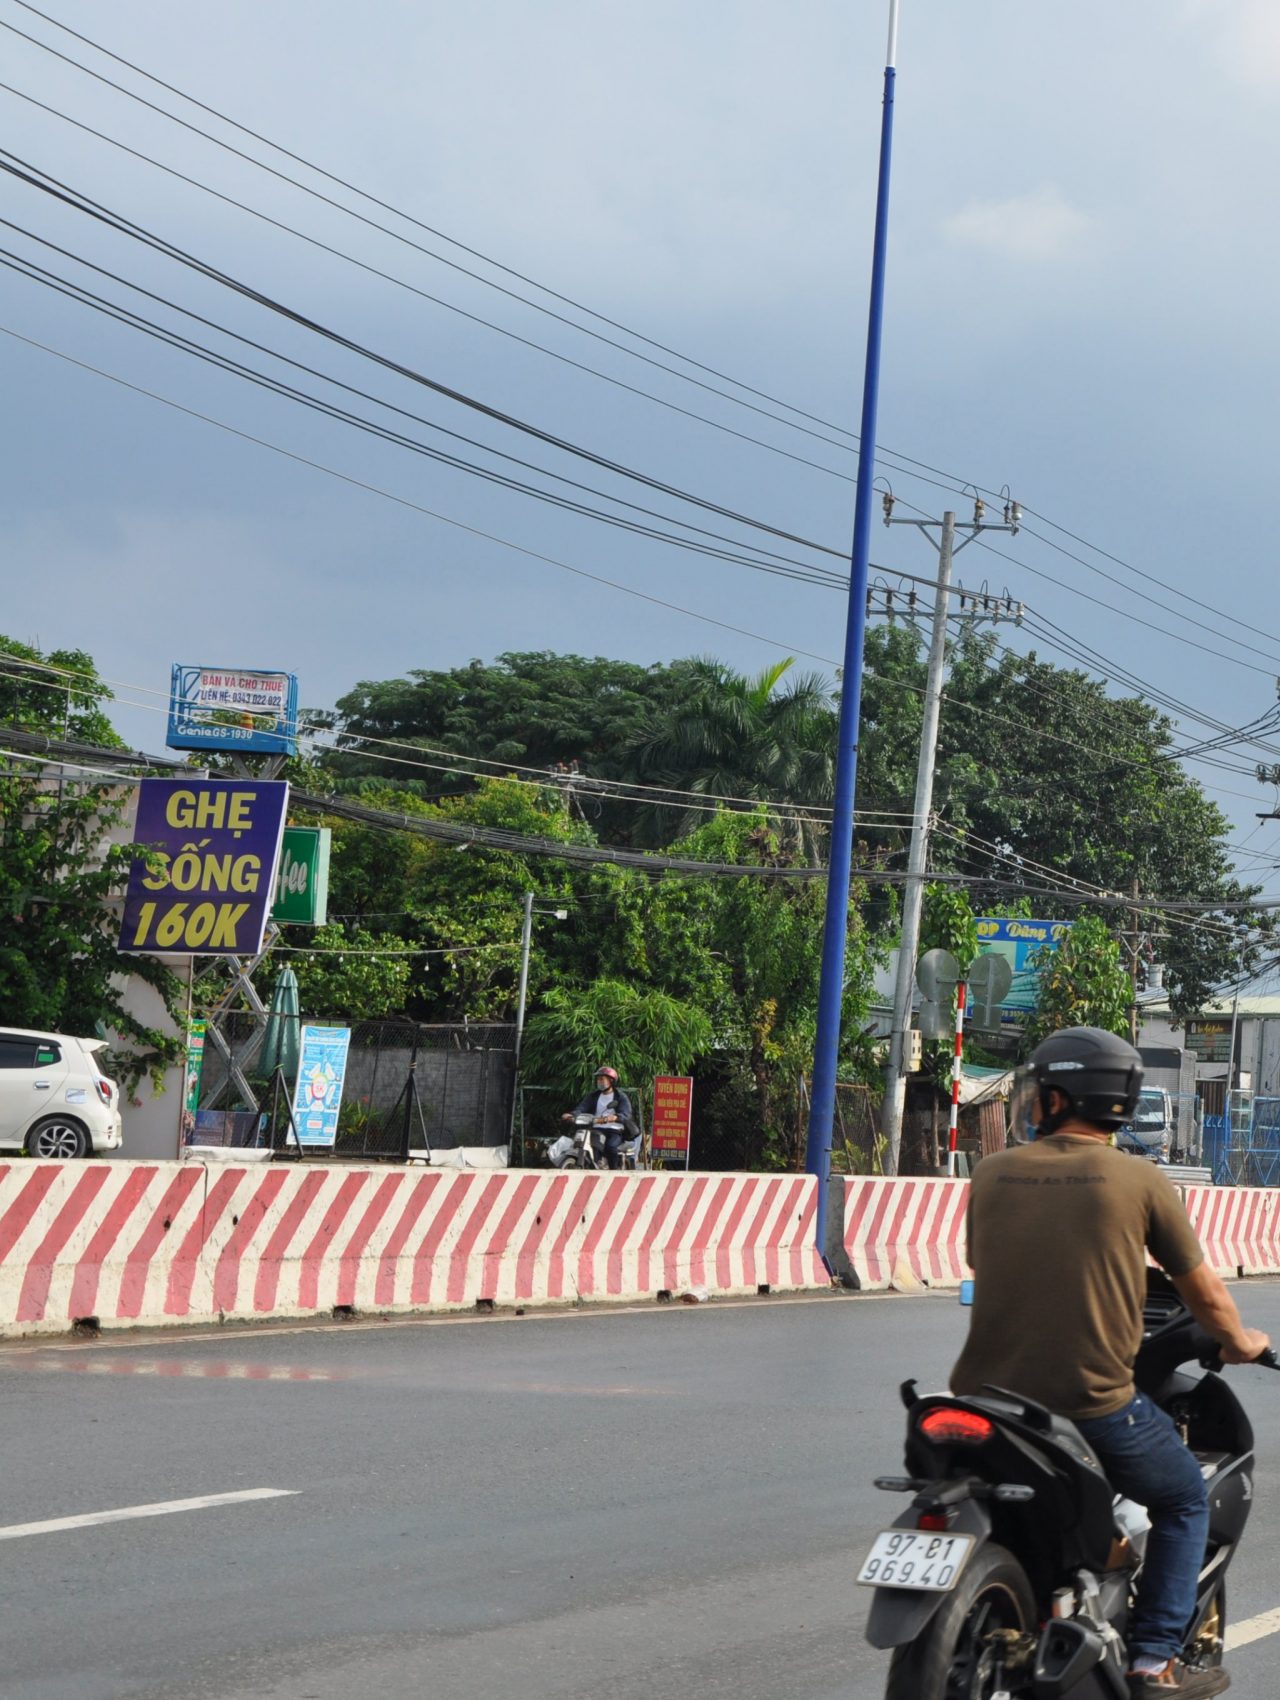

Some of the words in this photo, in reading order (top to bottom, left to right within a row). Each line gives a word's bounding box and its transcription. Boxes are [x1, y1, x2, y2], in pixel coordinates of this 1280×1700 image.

[239, 678, 258, 689] CHO
[166, 790, 257, 838] GHẸ
[142, 838, 261, 893] SỐNG
[133, 902, 250, 948] 160K
[864, 1558, 954, 1587] 969.40
